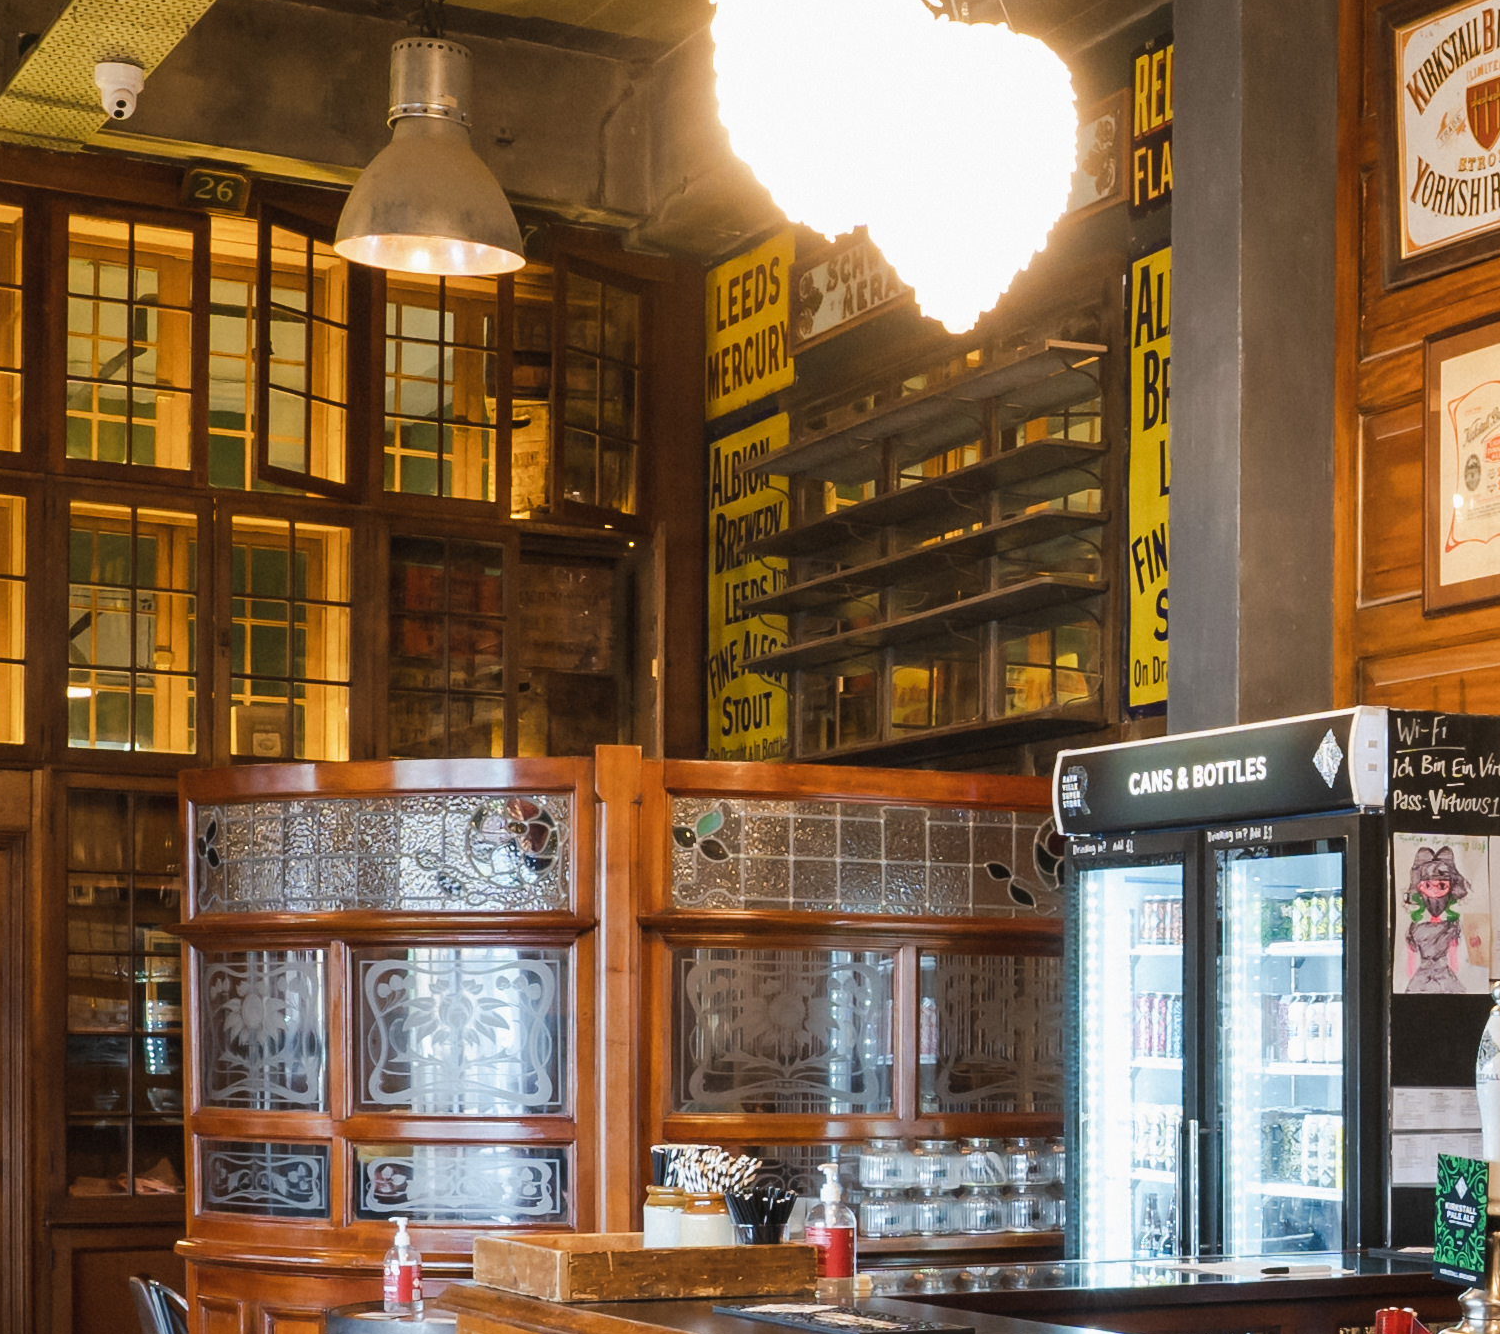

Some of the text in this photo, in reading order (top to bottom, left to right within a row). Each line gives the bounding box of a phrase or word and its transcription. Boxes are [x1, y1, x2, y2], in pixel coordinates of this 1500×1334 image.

[1405, 17, 1482, 116] KIRKSTALL
[194, 176, 234, 203] 26
[716, 255, 781, 333] LEEDS
[707, 320, 790, 403] MERCURY
[709, 639, 738, 700] FINE
[721, 690, 773, 737] STOUT
[1396, 715, 1449, 747] Wi-Fi
[1129, 755, 1268, 796] CANS & BOTTLES
[1392, 756, 1415, 779] Ich
[1420, 754, 1447, 778] Bin
[1451, 756, 1477, 779] Ein
[1444, 1201, 1478, 1216] KIRKSTALL
[1446, 1210, 1476, 1223] PALE ALE
